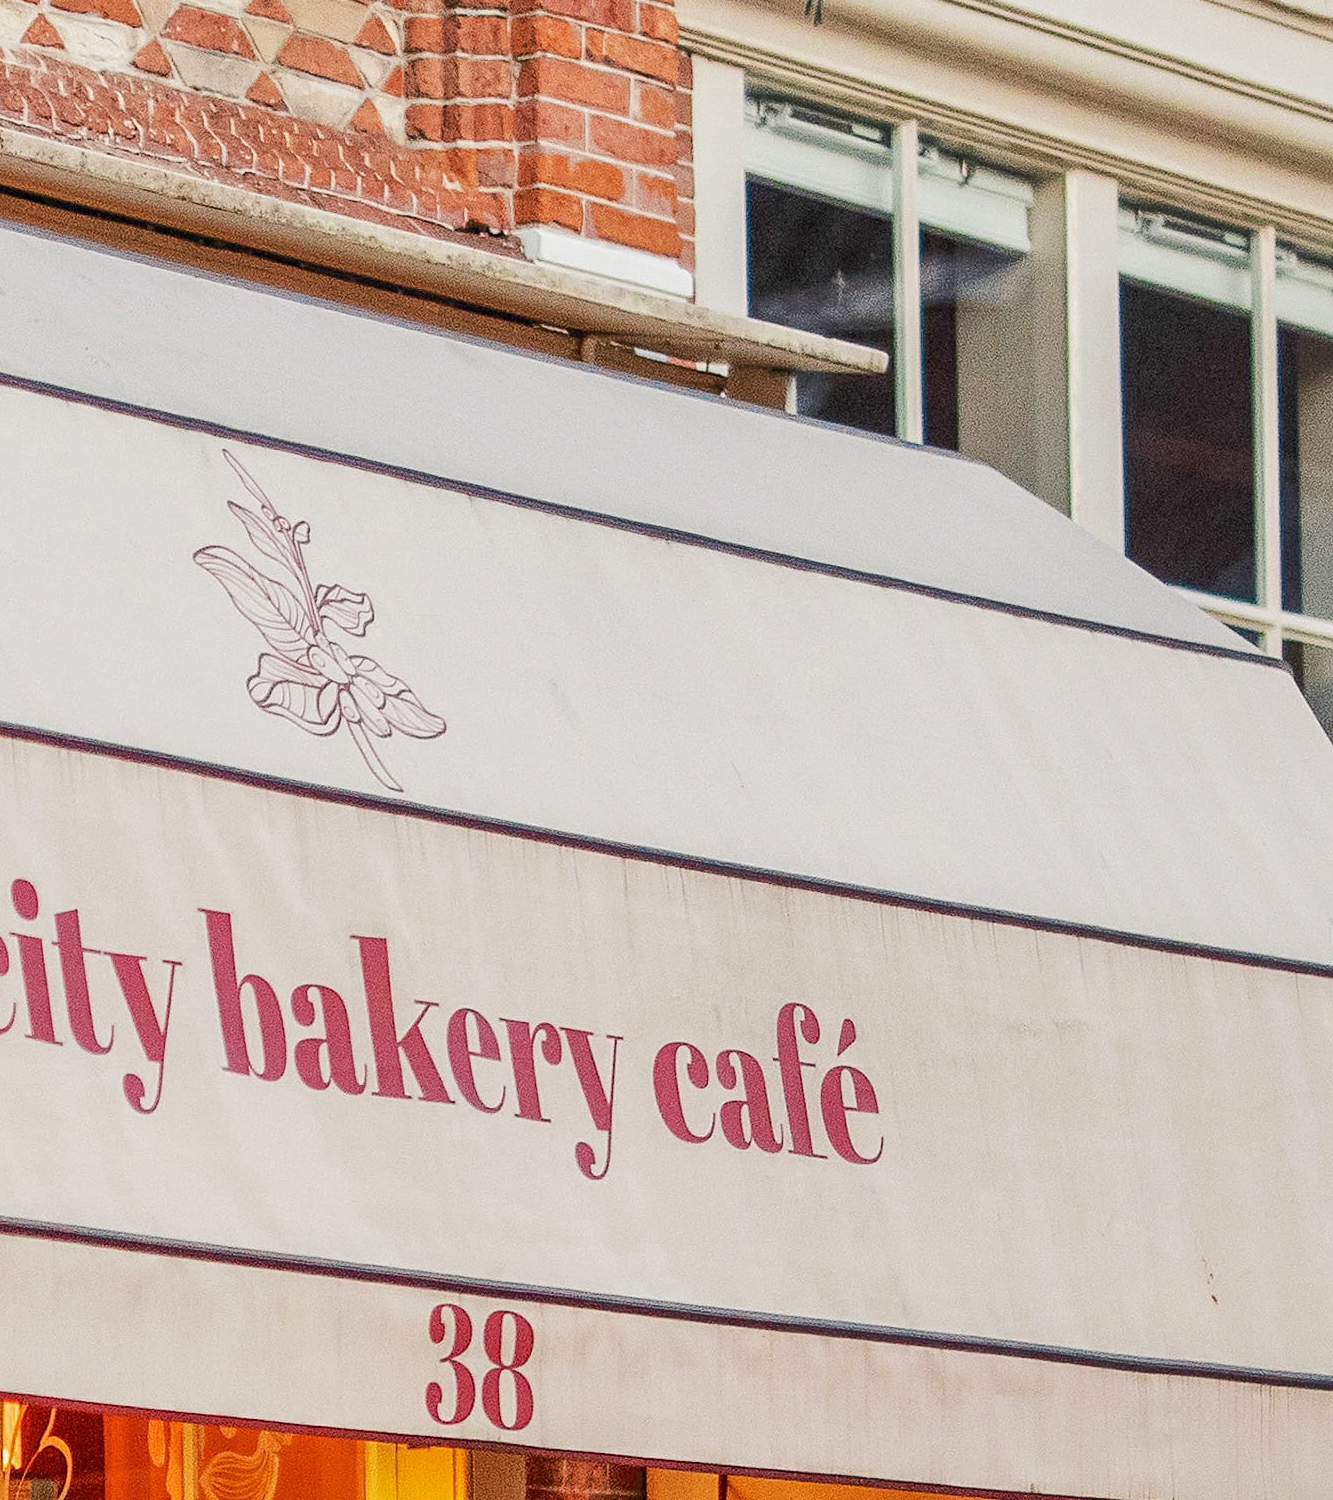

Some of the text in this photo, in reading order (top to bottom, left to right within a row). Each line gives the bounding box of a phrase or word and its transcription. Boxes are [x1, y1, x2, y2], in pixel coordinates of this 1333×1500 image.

[195, 906, 625, 1184] bakery
[651, 1002, 885, 1168] café
[425, 1302, 536, 1434] 38
